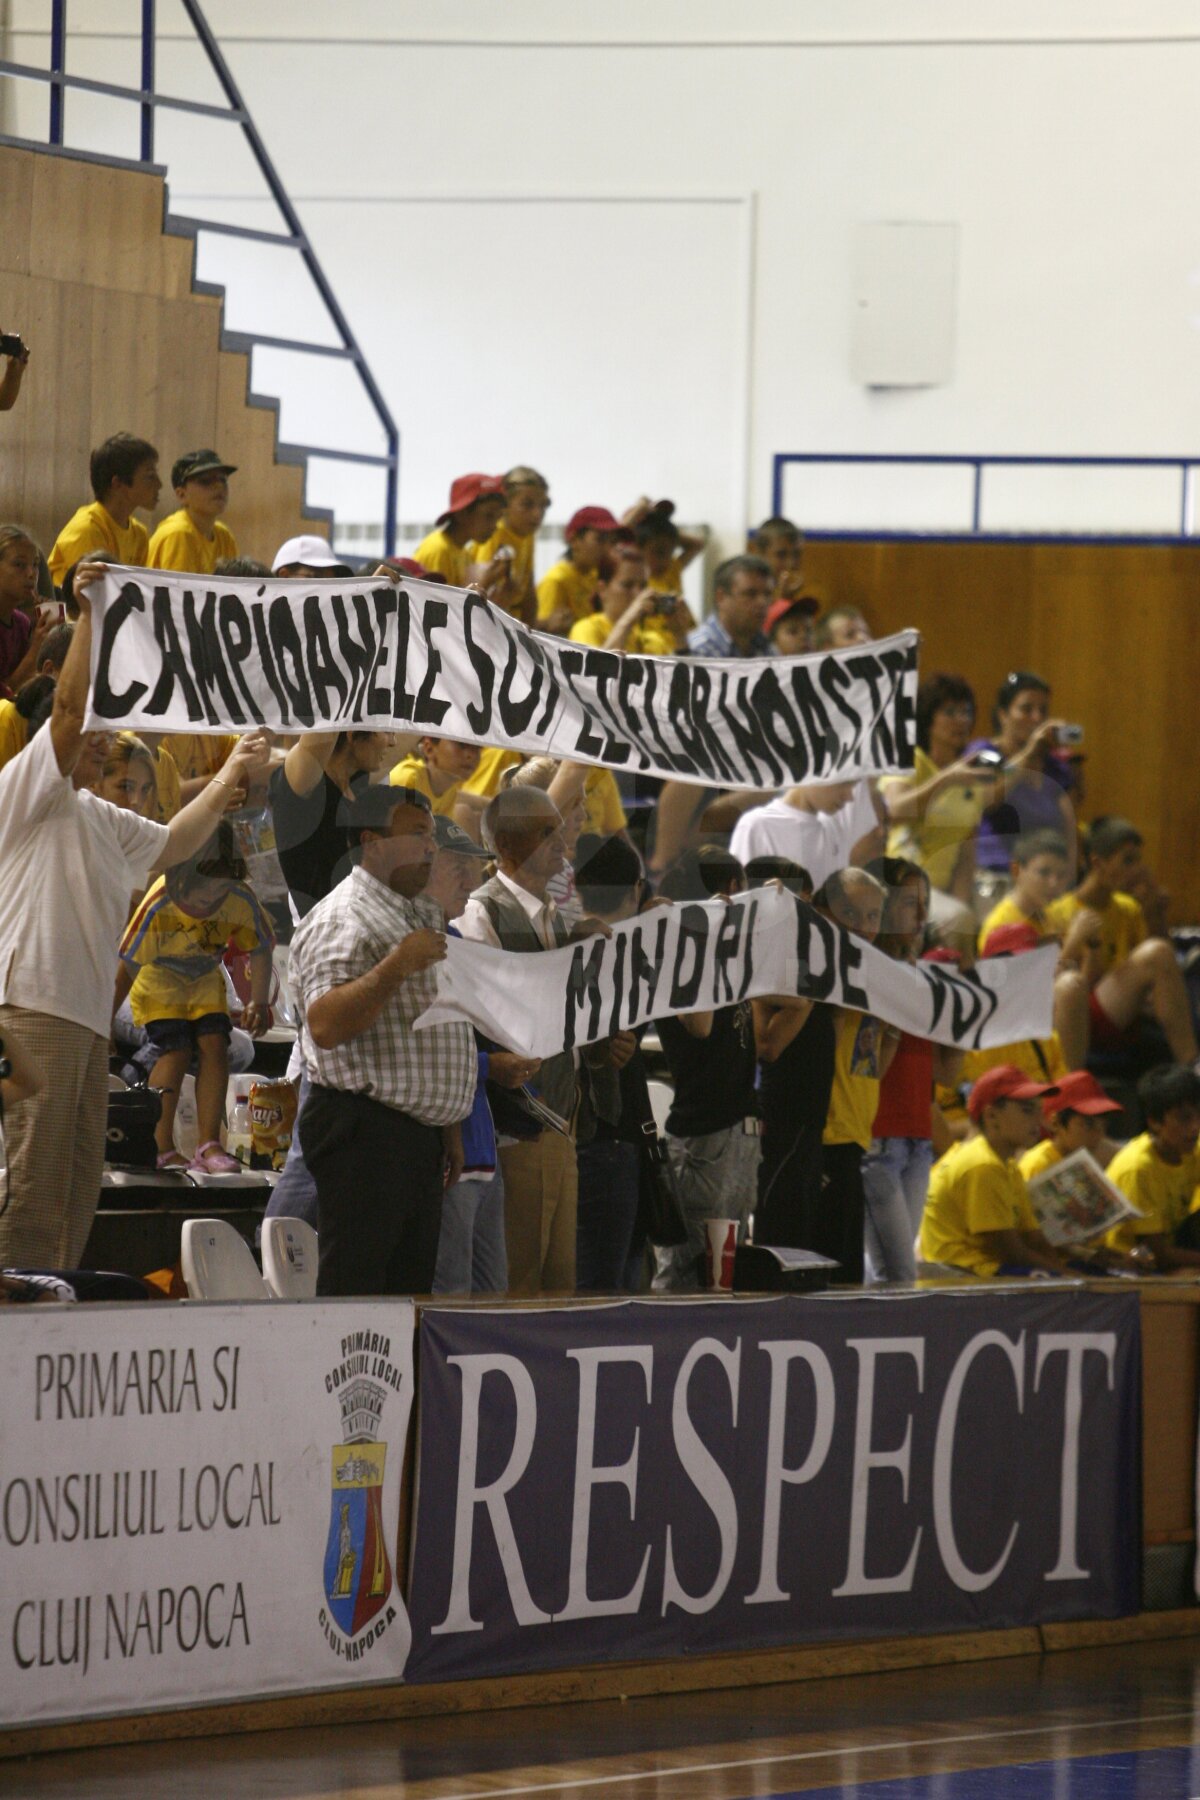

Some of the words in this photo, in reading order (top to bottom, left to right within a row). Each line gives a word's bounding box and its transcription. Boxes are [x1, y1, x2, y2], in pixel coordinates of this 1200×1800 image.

[796, 898, 870, 1010] DE
[35, 1347, 202, 1421] PRIMARIA
[212, 1345, 242, 1411] SI
[324, 1354, 369, 1394] CONSILIUL
[371, 1357, 403, 1392] LOCAL
[0, 1469, 164, 1547] ONSILIUL
[177, 1462, 281, 1533] LOCAL
[430, 1329, 1117, 1636] RESPECT
[12, 1596, 92, 1677] CLUJ
[104, 1582, 251, 1660] NAPOCA
[318, 1605, 397, 1662] CLUJ-NAPOCA
